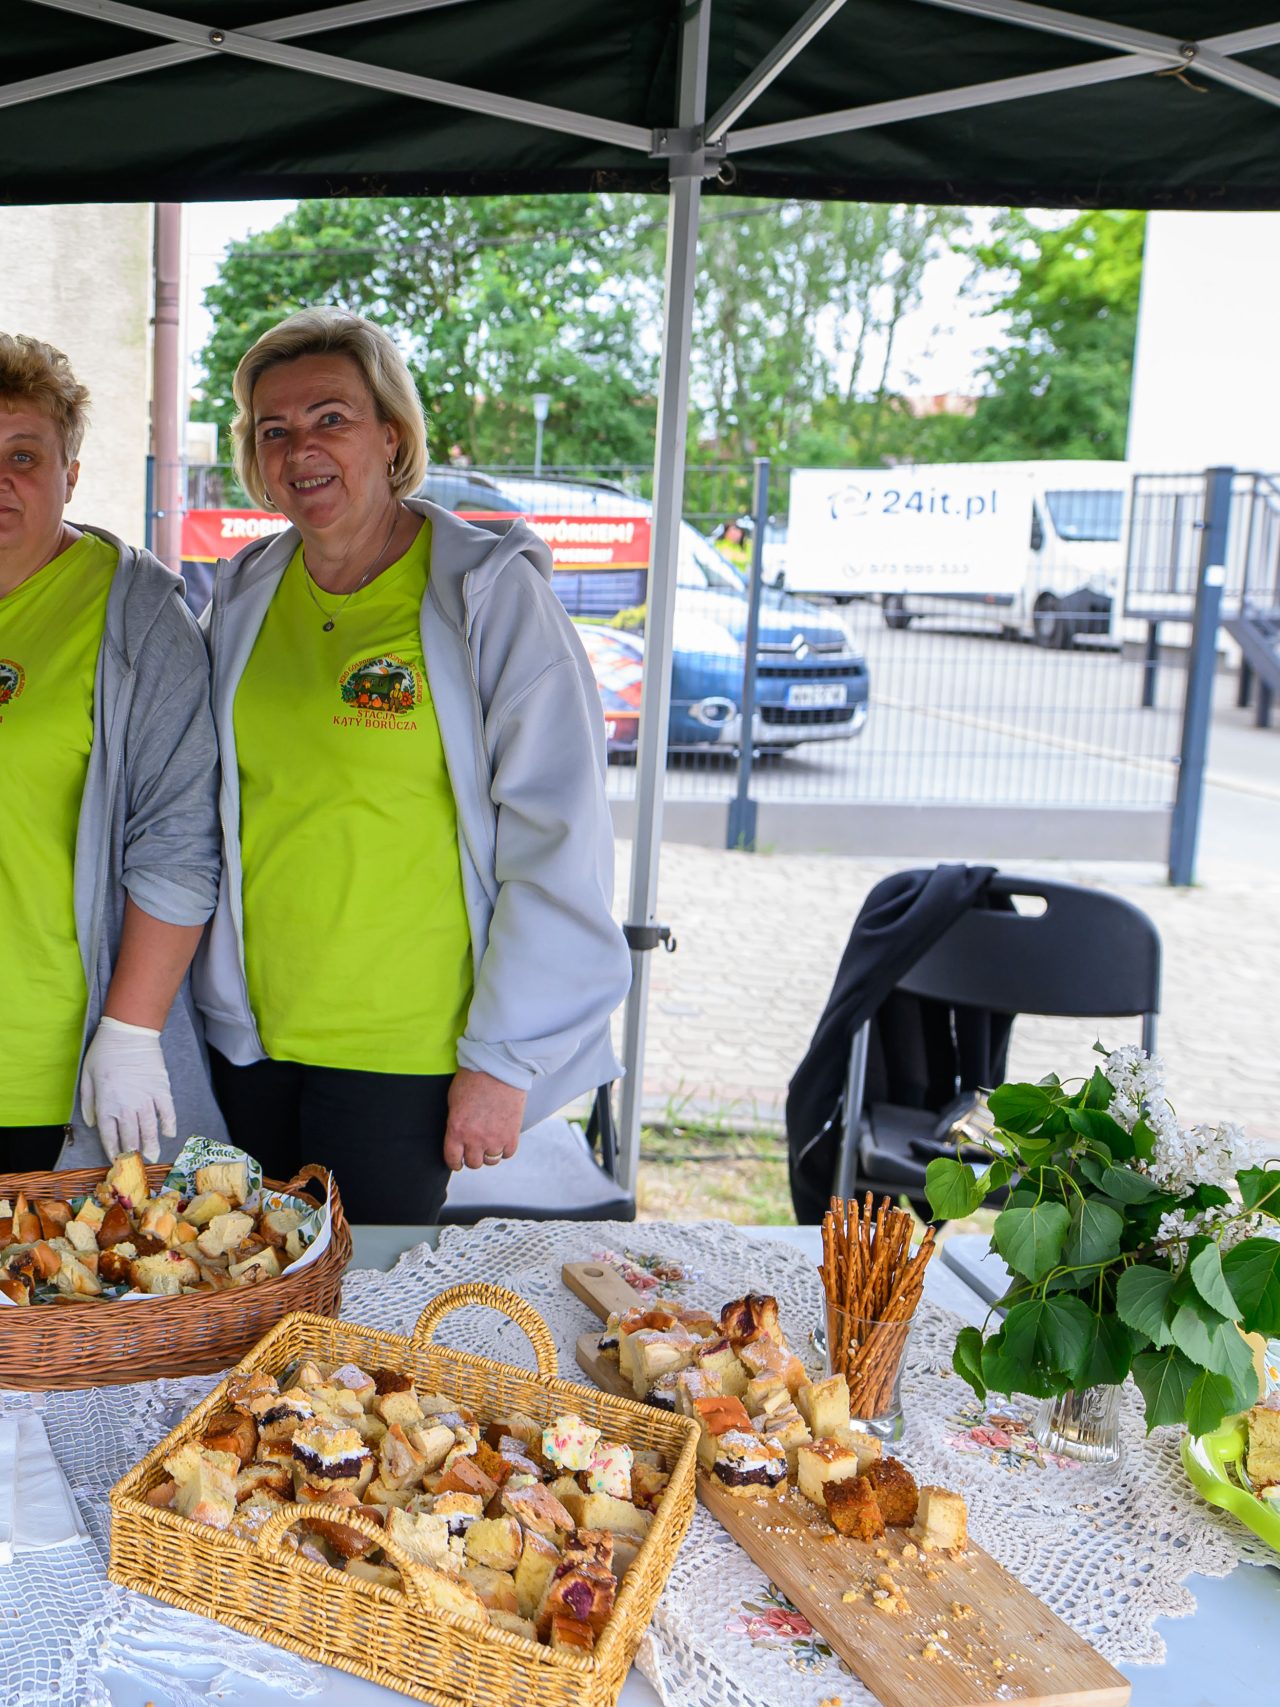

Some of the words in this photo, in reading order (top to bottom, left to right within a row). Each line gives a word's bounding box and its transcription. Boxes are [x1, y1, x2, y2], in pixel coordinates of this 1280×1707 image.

[882, 487, 998, 520] 24it.pl
[333, 715, 361, 727] KĄTY
[365, 719, 417, 731] BORUCZA
[357, 709, 396, 721] STACJA
